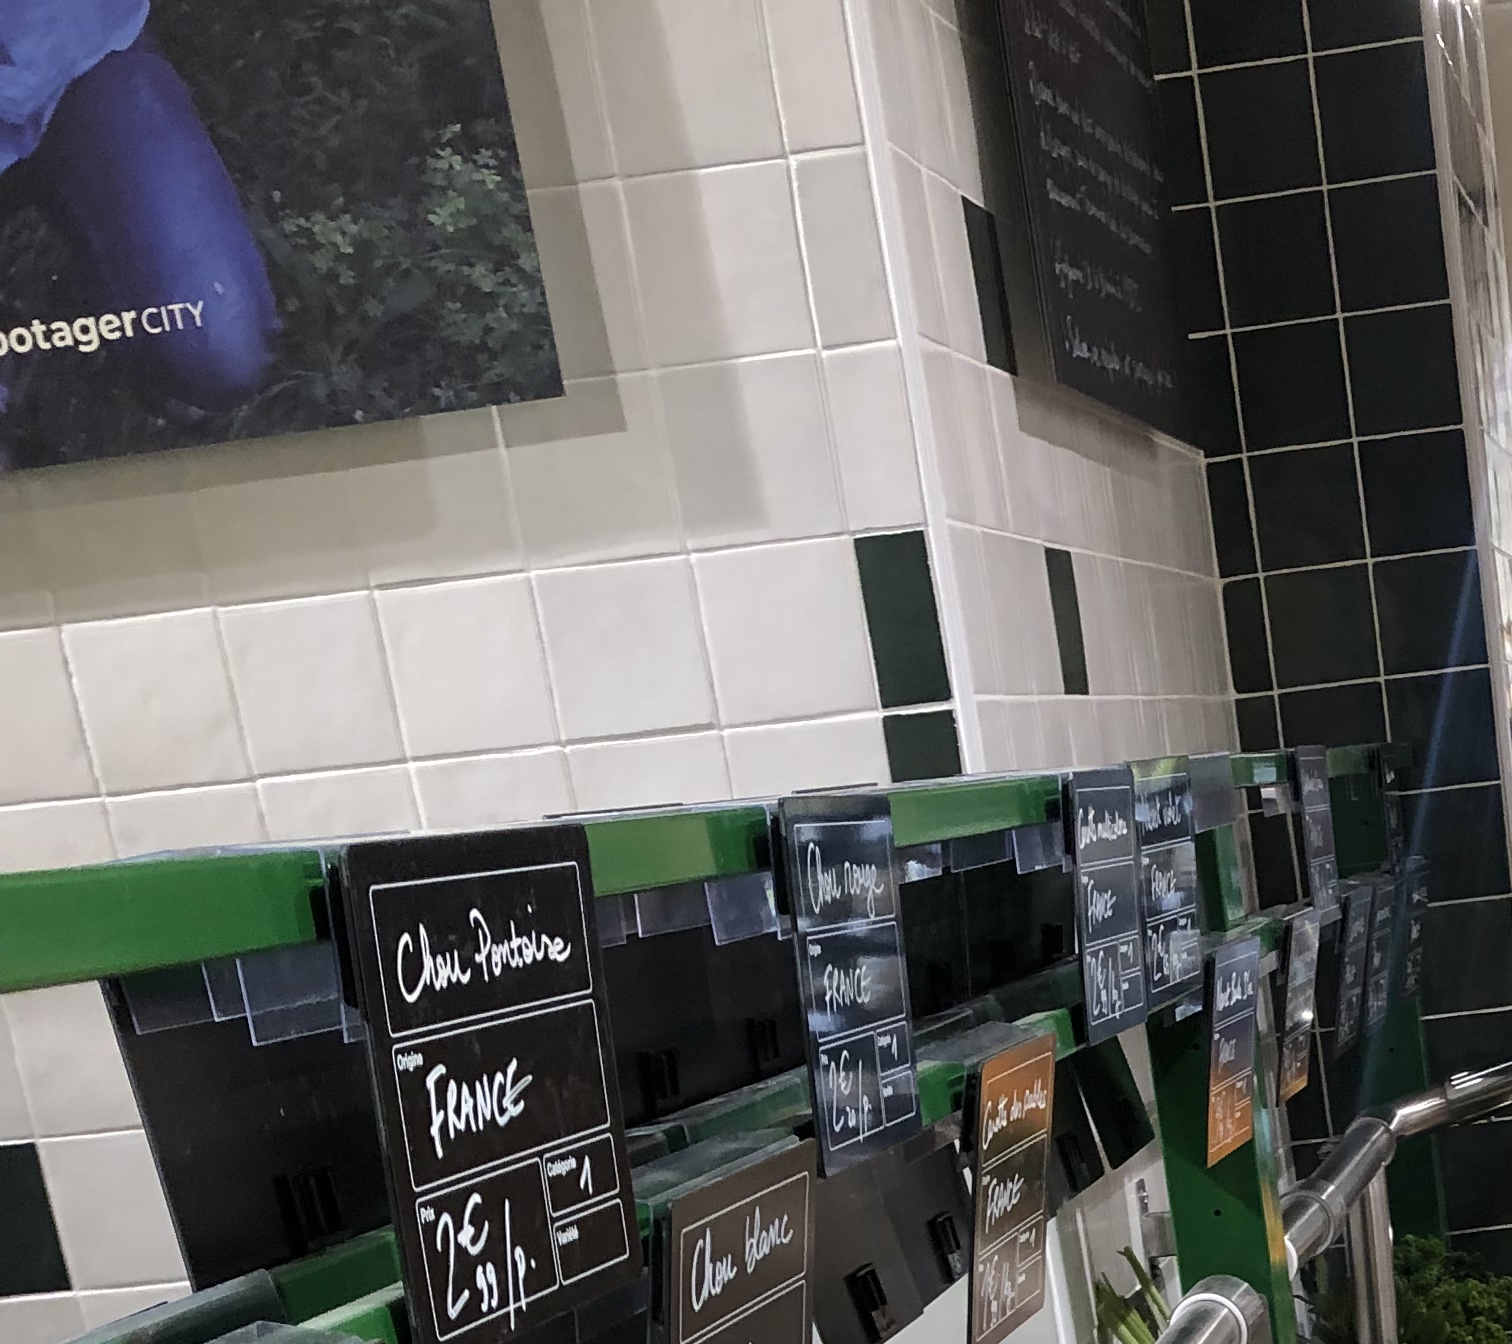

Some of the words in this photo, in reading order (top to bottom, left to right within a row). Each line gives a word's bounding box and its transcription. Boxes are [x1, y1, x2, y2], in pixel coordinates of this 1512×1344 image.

[807, 842, 842, 914] Chou
[844, 860, 884, 918] rouge
[397, 923, 472, 1003] Chou
[470, 904, 572, 985] Pontoise
[824, 964, 872, 1021] FRANCE
[426, 1057, 533, 1160] FRANCE
[580, 1154, 594, 1195] 1
[690, 1227, 737, 1313] Chou
[744, 1206, 794, 1275] blanc
